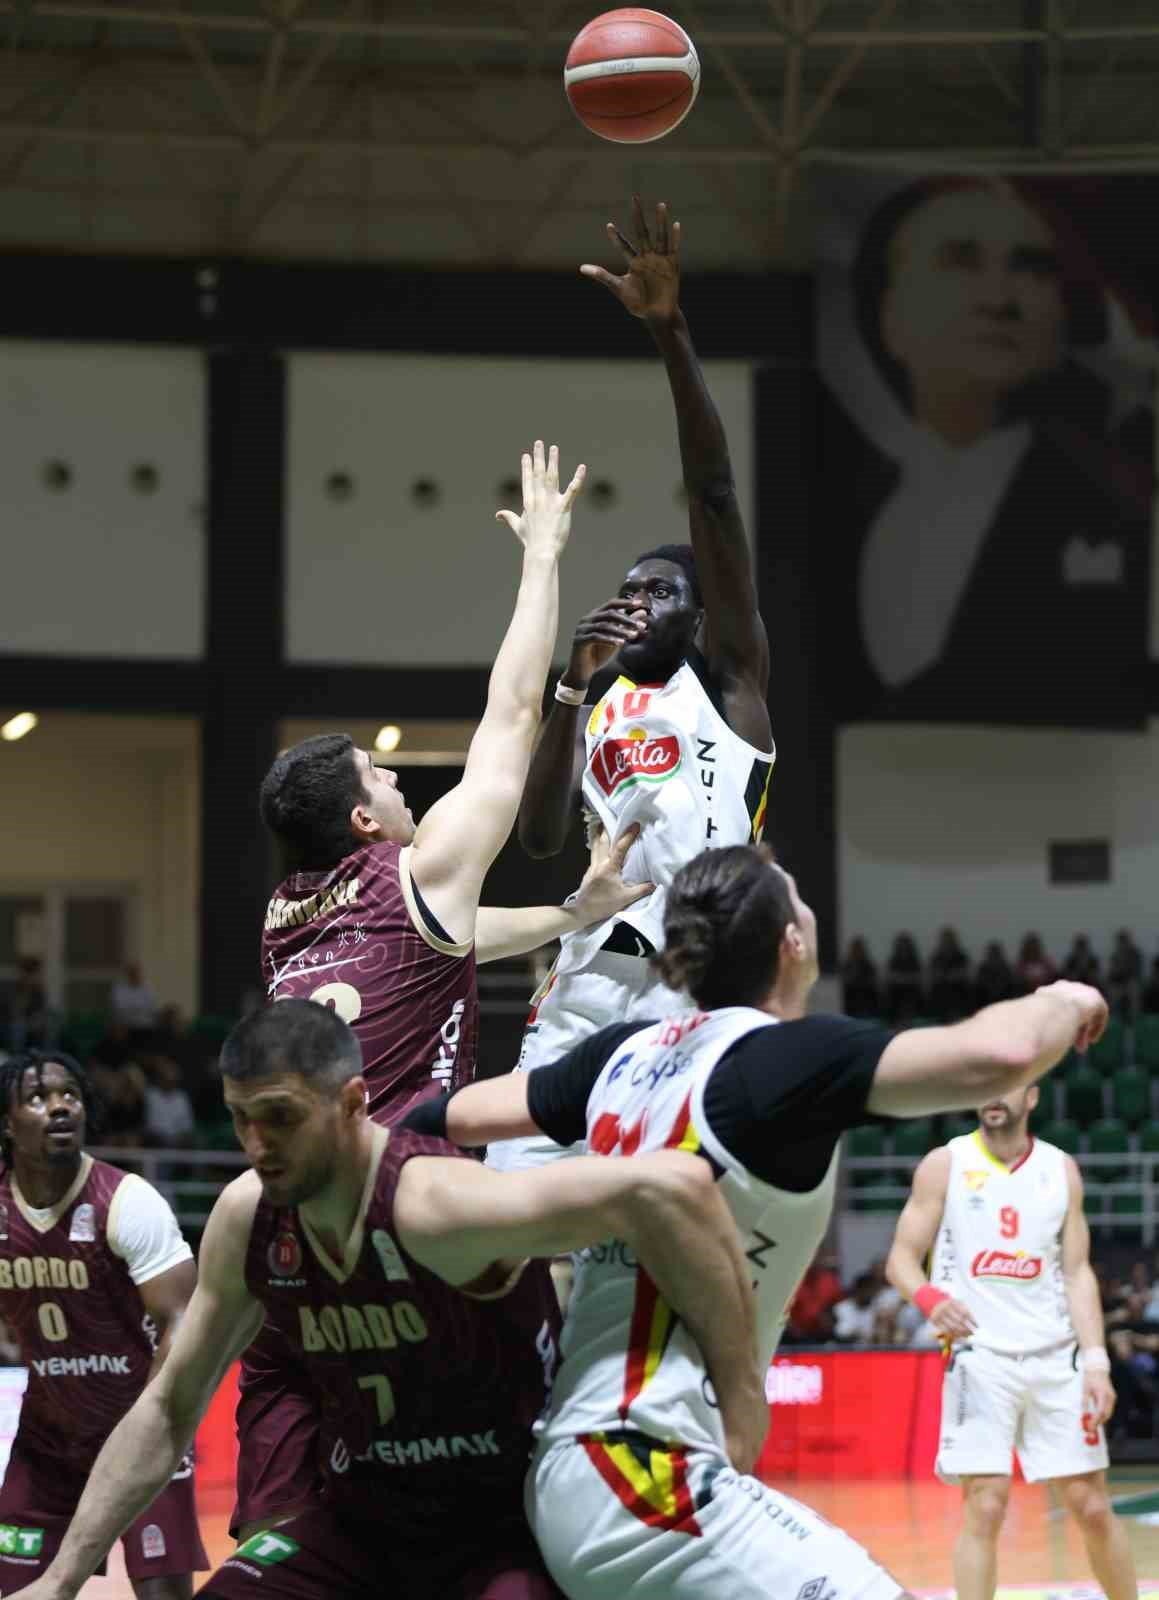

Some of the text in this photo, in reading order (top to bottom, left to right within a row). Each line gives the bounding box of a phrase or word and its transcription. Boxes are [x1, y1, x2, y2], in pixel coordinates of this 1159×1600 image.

[600, 739, 671, 785] Lezita
[998, 1205, 1019, 1239] 9
[0, 1256, 89, 1290] BORDO
[38, 1302, 68, 1341] 0
[299, 1301, 428, 1352] BORDO
[32, 1354, 131, 1377] YEMMAK
[357, 1374, 396, 1425] 7
